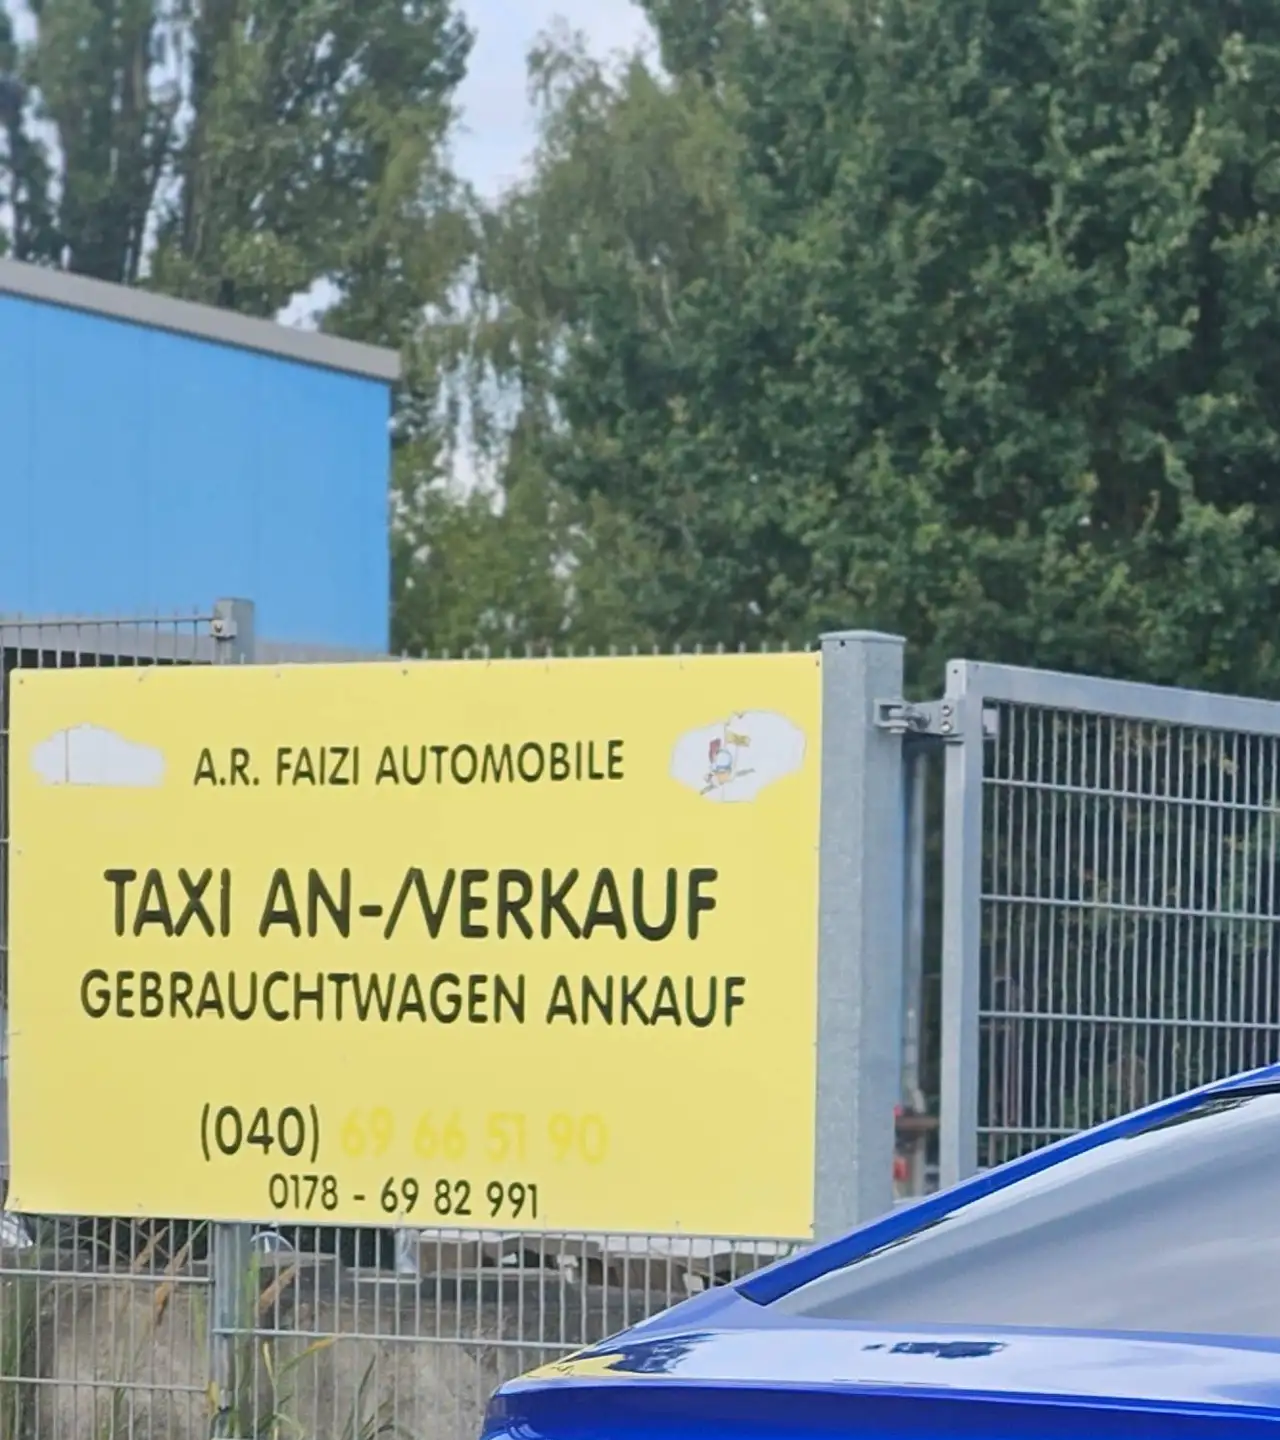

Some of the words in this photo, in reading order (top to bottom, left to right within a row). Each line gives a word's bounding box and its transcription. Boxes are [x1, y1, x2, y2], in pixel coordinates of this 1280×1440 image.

[193, 747, 260, 786] A.R.
[276, 746, 359, 786] FAIZI
[375, 739, 625, 786] AUTOMOBILE
[104, 867, 231, 938] TAXI
[80, 968, 526, 1025] GEBRAUCHTWAGEN
[545, 974, 746, 1027] ANKAUF
[200, 1102, 320, 1164] (040)
[339, 1106, 395, 1158] 69
[413, 1106, 468, 1161] 66
[486, 1111, 527, 1163] 51
[547, 1112, 610, 1165] 90
[268, 1173, 338, 1211] 0178
[381, 1177, 419, 1214] 69
[434, 1179, 472, 1216] 82
[486, 1180, 538, 1219] 991
